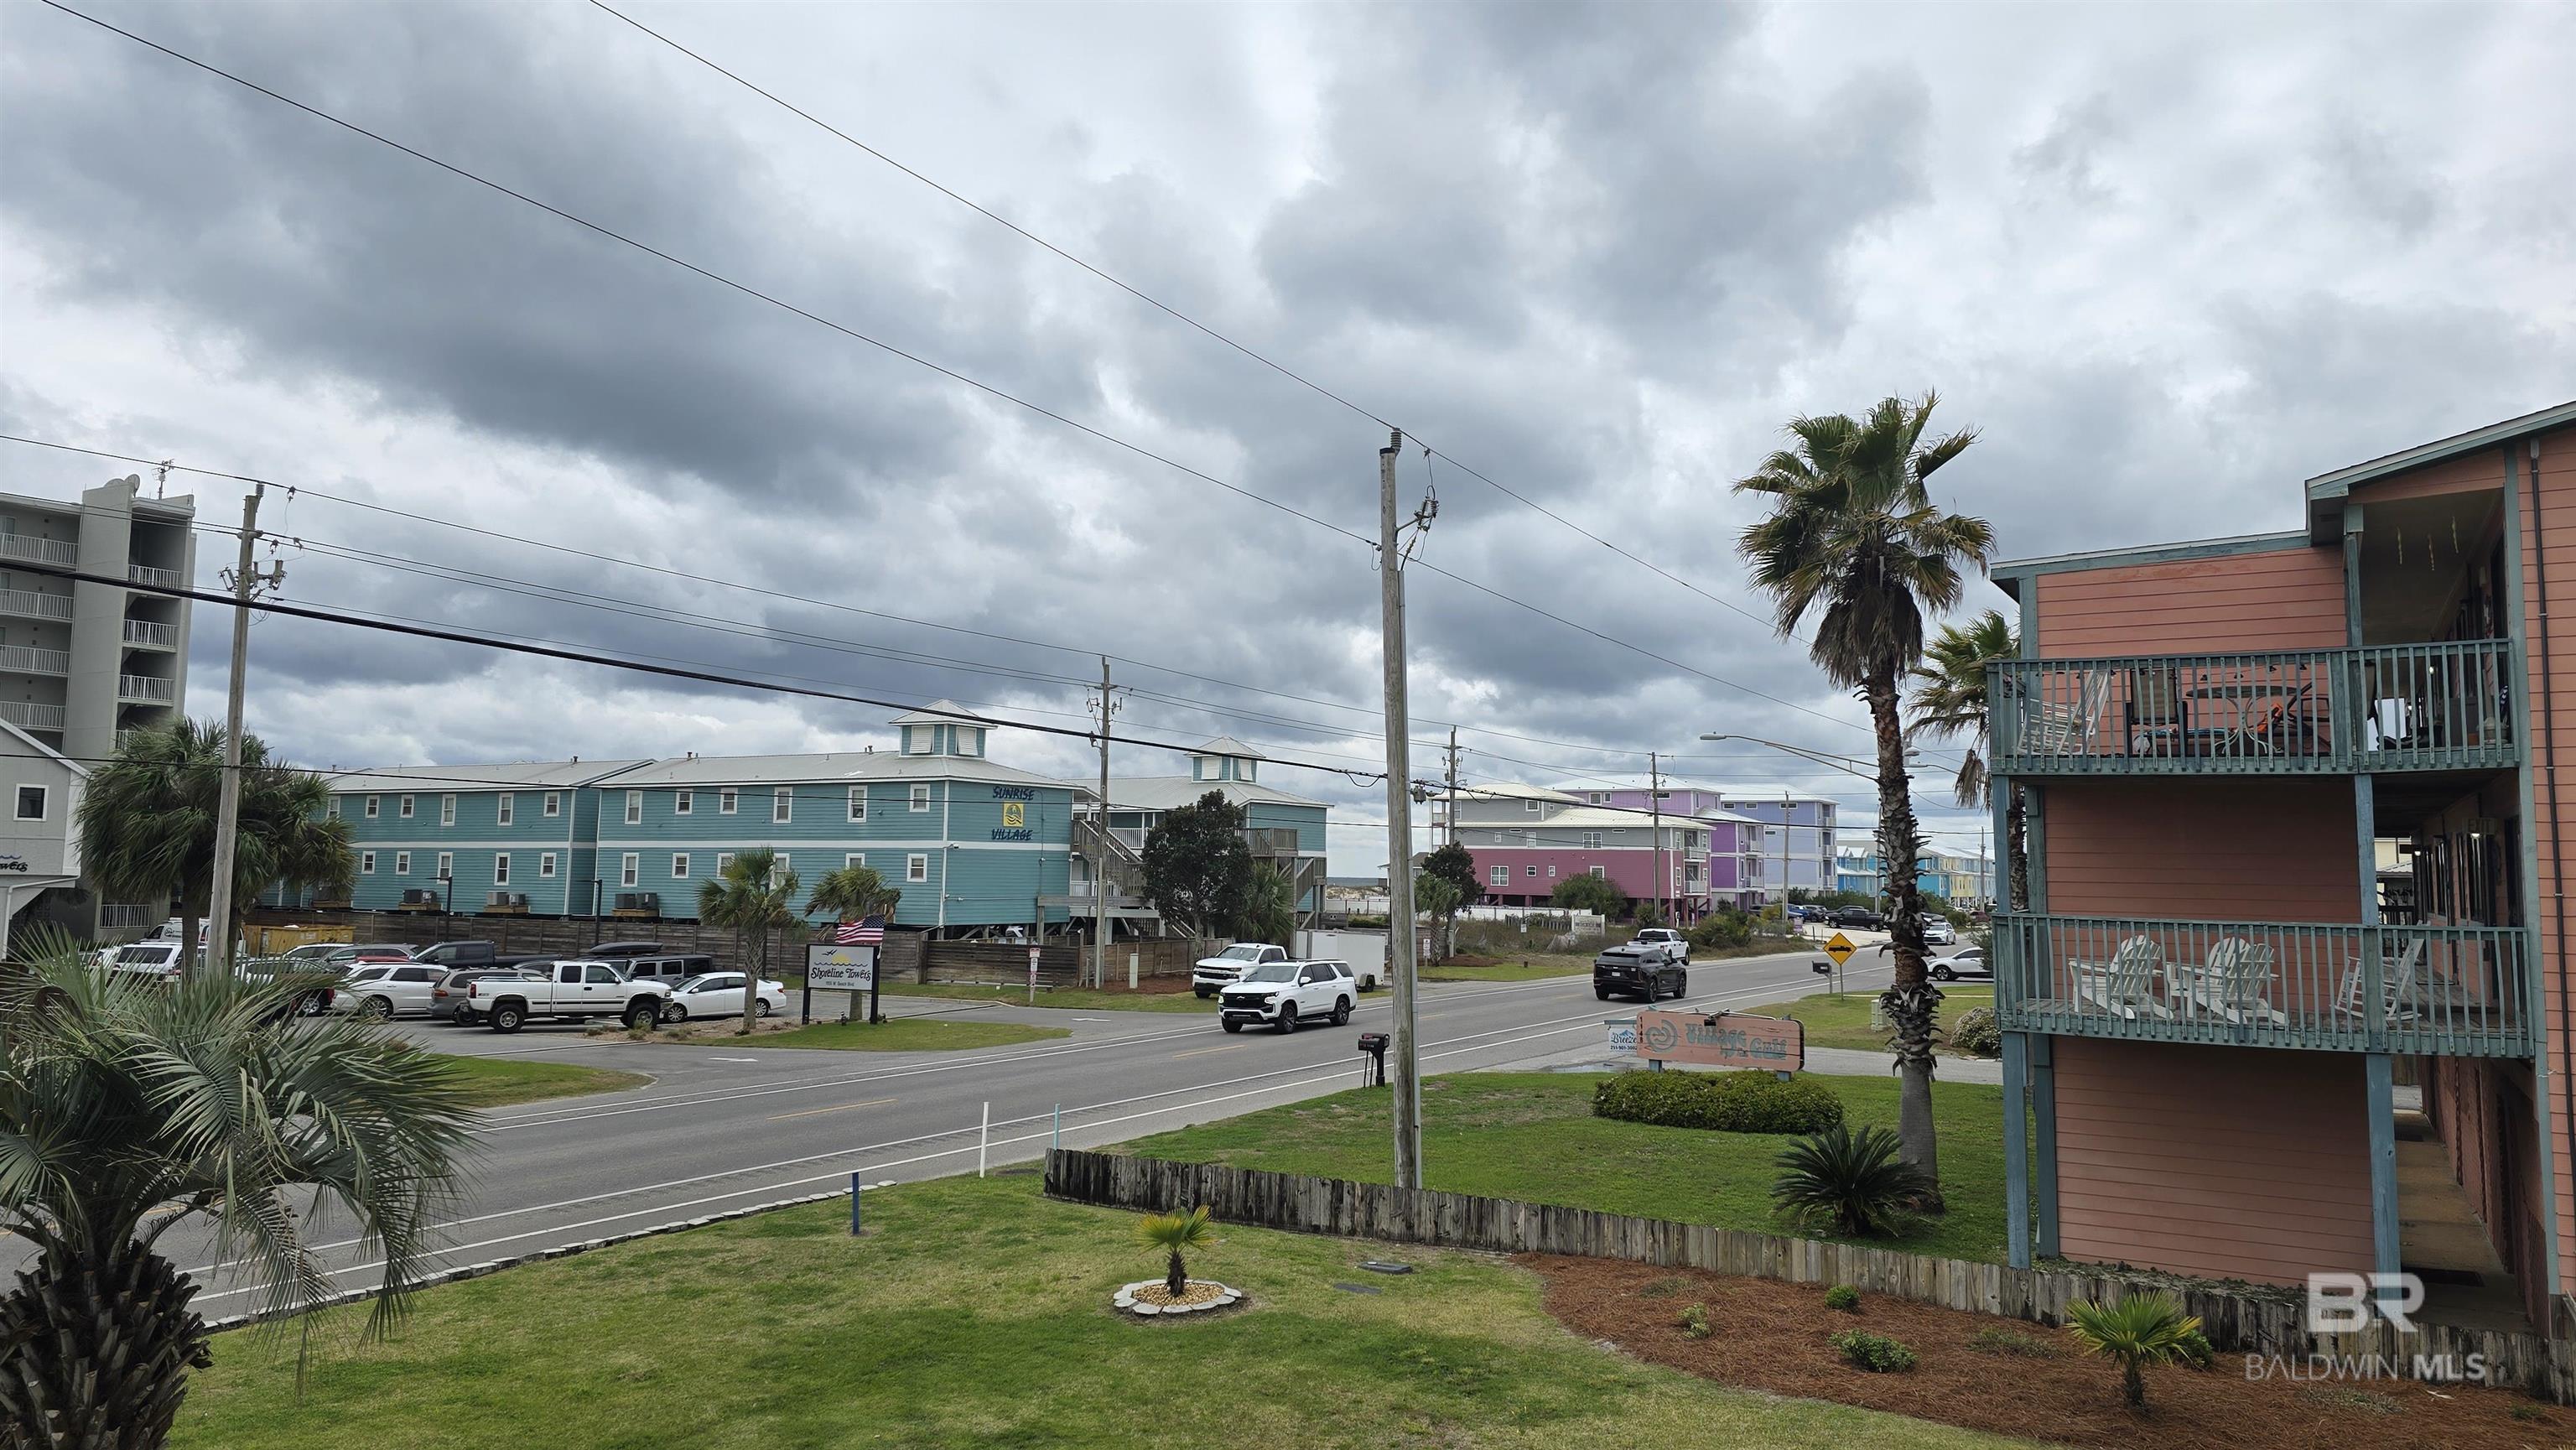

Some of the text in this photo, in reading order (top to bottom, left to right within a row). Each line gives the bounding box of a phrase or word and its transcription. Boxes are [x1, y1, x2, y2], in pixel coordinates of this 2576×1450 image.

[993, 786, 1034, 800] SUNRISE
[991, 829, 1033, 840] VILLAGE
[0, 861, 28, 872] wers
[810, 967, 870, 981] Shoreline Towers
